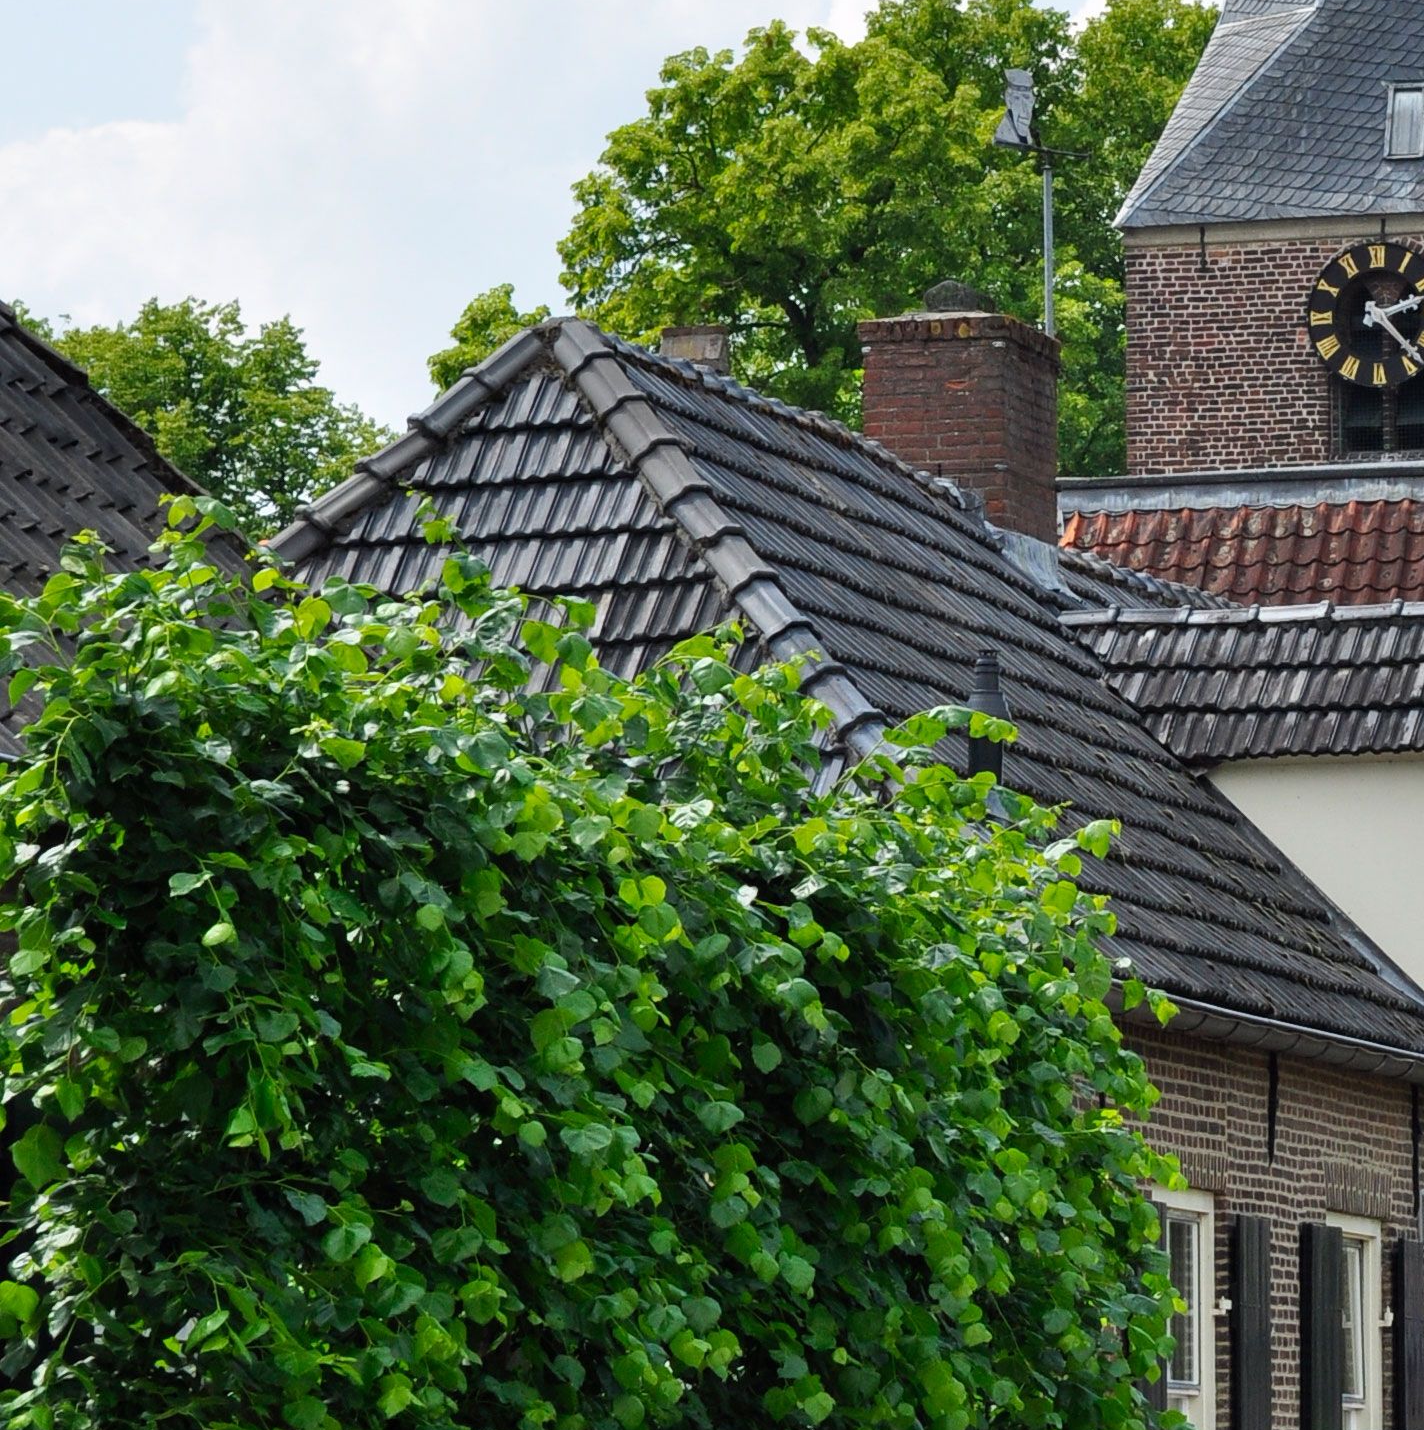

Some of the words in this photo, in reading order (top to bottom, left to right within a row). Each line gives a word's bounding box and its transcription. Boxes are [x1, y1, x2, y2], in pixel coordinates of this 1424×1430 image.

[1338, 253, 1359, 279] XI
[1368, 245, 1386, 268] XII
[1398, 251, 1413, 273] I
[1317, 279, 1340, 297] X
[1310, 311, 1333, 326] IX
[1316, 334, 1341, 360] VIII
[1339, 355, 1360, 380] VII
[1373, 362, 1387, 385] VI
[1401, 355, 1418, 376] V
